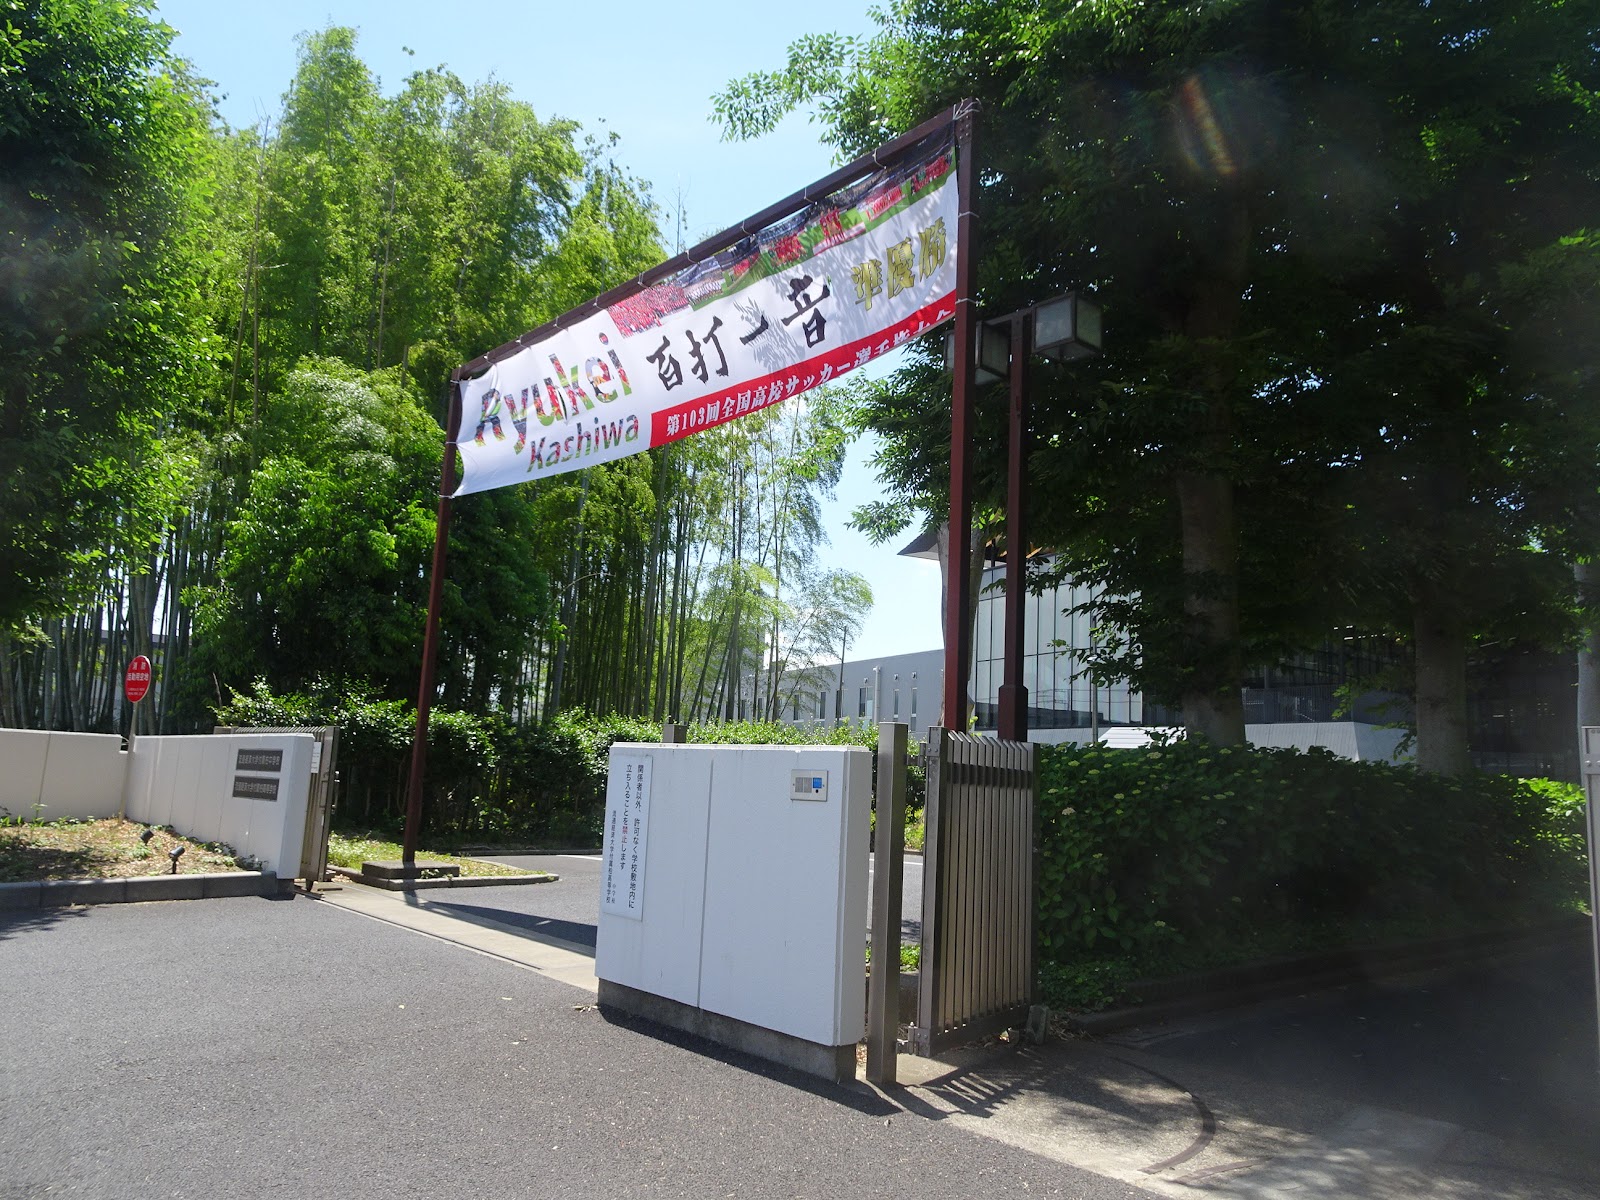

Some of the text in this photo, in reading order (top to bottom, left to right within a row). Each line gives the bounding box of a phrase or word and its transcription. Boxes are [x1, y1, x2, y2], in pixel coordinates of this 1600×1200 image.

[851, 216, 946, 311] 準優勝
[646, 275, 830, 391] 百打一音
[475, 332, 632, 455] Ryukei
[527, 414, 639, 472] Kashiwa
